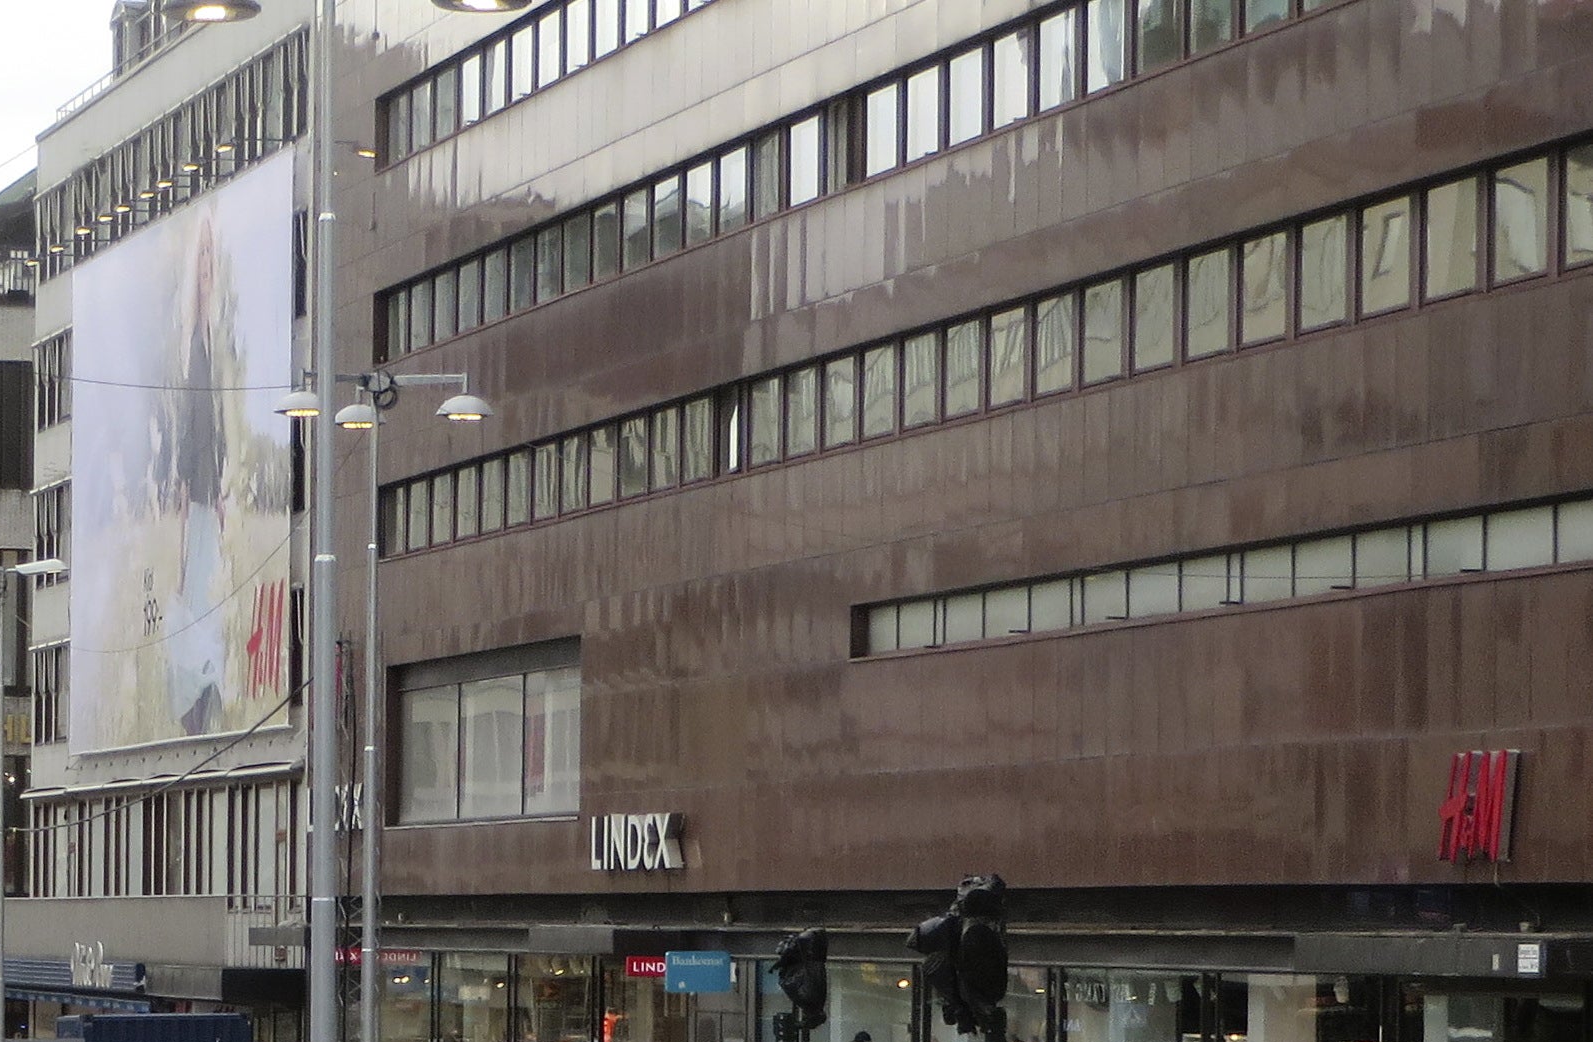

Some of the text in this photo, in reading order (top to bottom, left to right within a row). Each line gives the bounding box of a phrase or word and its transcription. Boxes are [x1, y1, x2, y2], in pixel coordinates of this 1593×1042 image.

[246, 578, 284, 700] H&M
[591, 813, 672, 871] LINDEX
[1438, 750, 1508, 864] H&M
[632, 961, 666, 973] LIND
